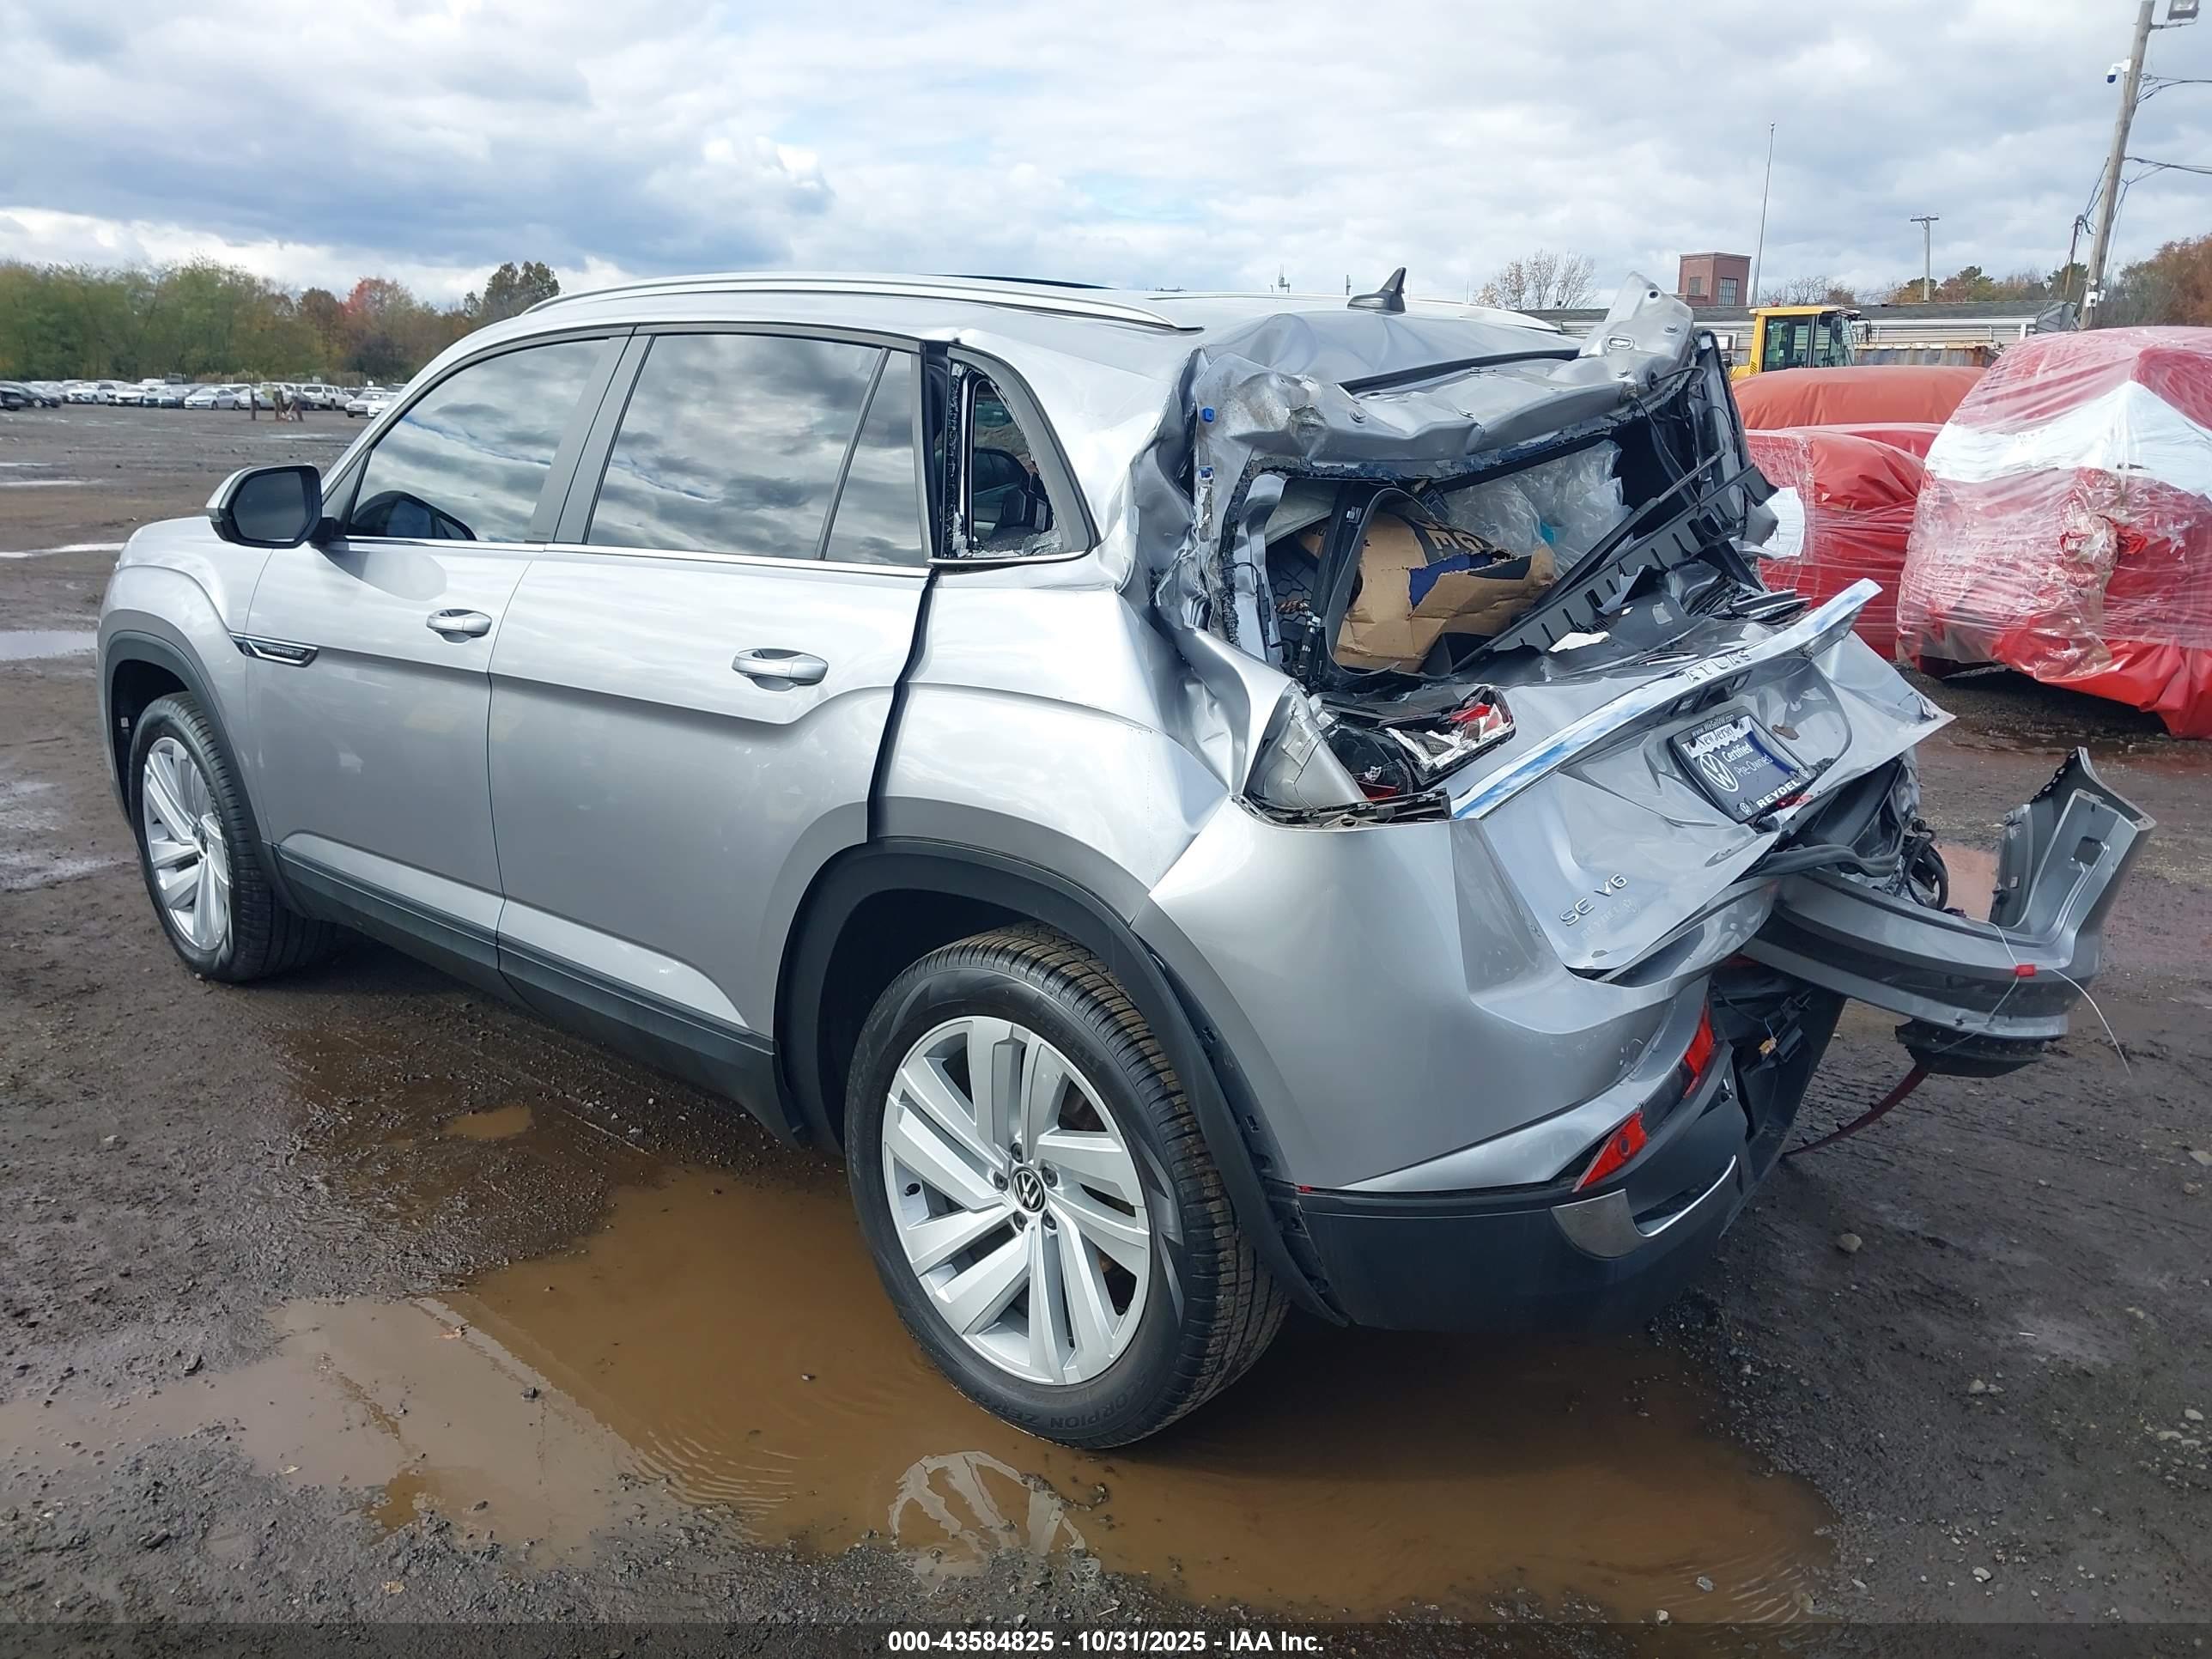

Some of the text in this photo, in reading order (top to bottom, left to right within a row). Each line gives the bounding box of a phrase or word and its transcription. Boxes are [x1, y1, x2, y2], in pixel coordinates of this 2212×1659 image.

[1684, 650, 1753, 683] ATLAS
[1697, 726, 1734, 749] New Jersey
[1722, 741, 1753, 763] Certified
[1734, 752, 1773, 777] Pre-Owned
[1699, 753, 1739, 792] VW
[1756, 780, 1802, 808] REYDEL
[1559, 897, 1595, 927] SE
[1594, 873, 1628, 897] V6
